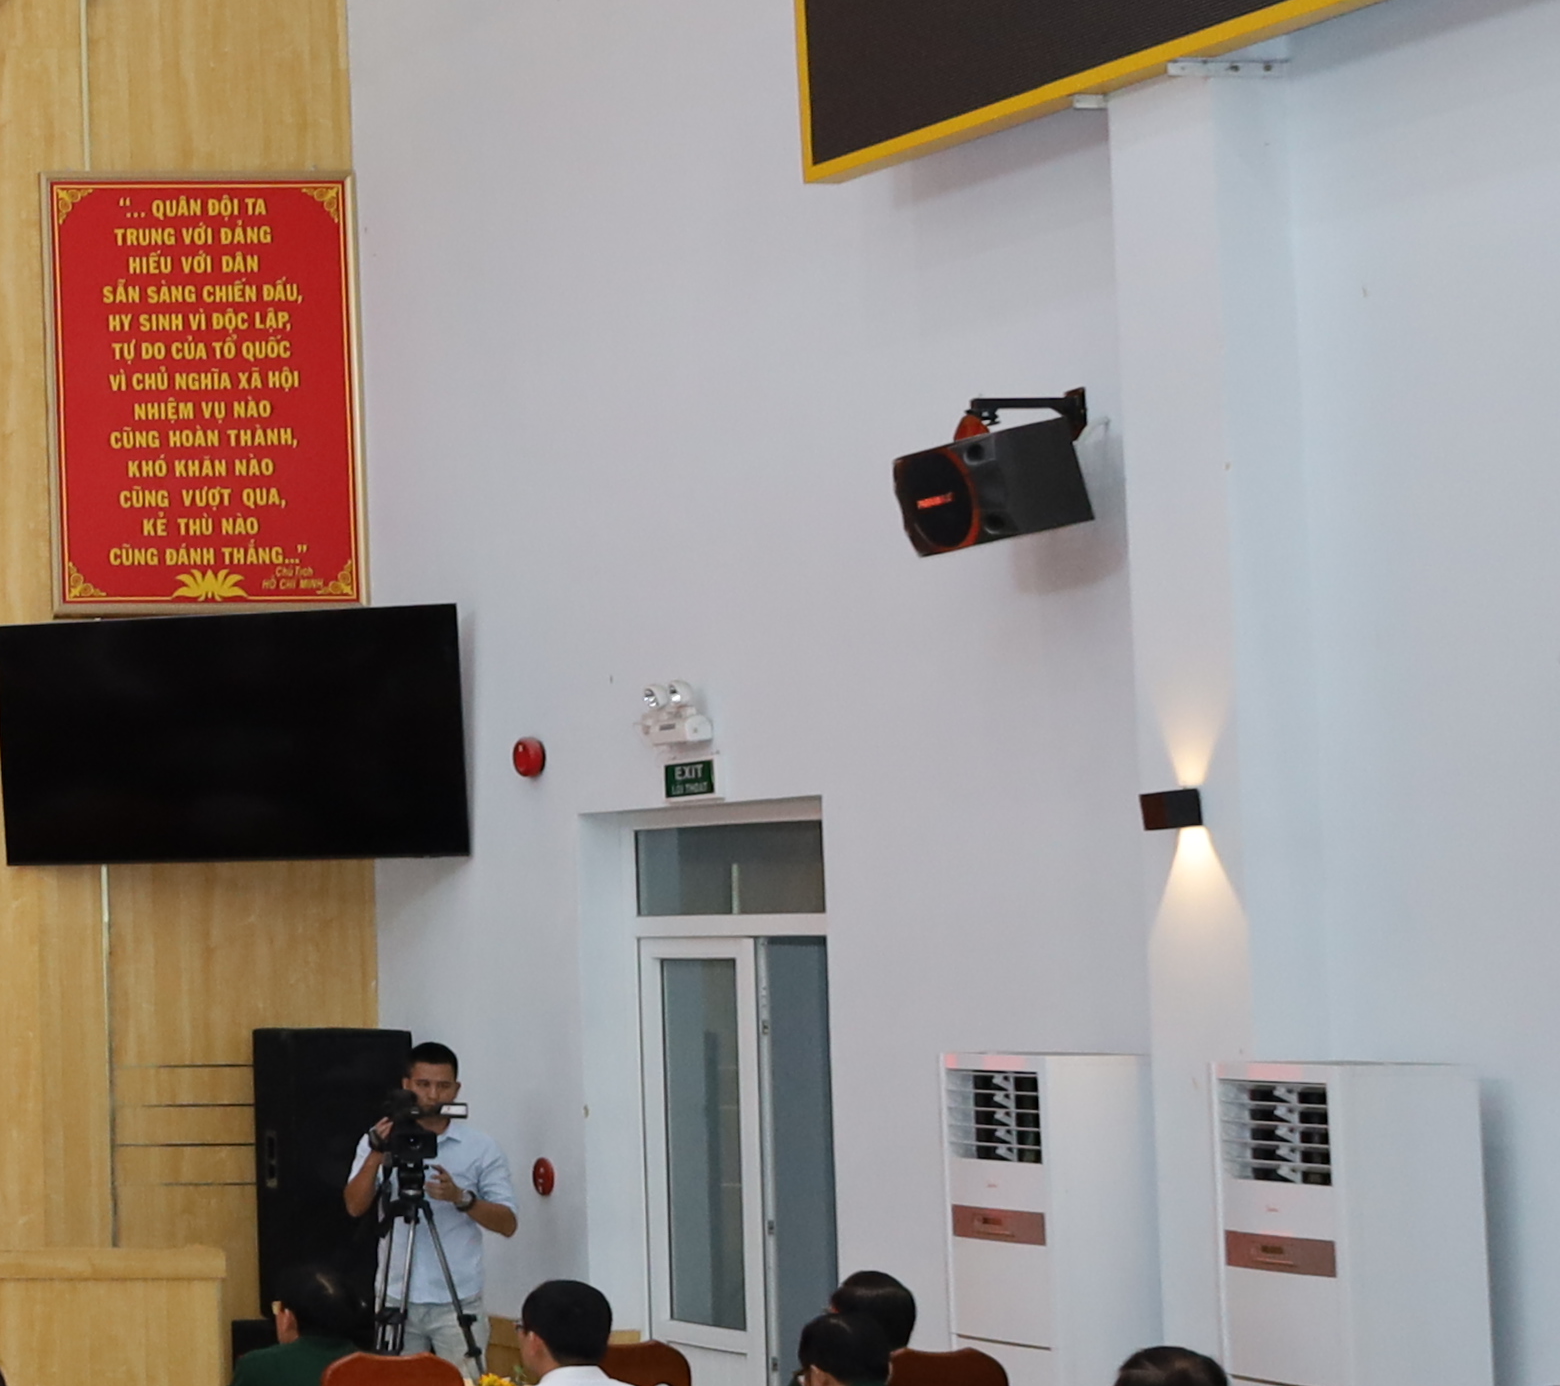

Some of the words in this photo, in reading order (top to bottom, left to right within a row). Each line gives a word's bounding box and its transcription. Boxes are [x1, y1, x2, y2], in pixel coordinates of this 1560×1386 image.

[152, 196, 201, 220] QUÂN
[208, 195, 241, 222] ĐỘI
[245, 198, 266, 215] TA
[114, 228, 175, 245] TRUNG
[182, 222, 212, 245] VỚI
[221, 220, 271, 244] ĐẢNG
[129, 250, 171, 274] HIẾU
[181, 251, 211, 273] VỚI
[222, 252, 258, 272] DÂN
[112, 339, 135, 364] TỰ
[142, 342, 165, 359] DO
[171, 336, 206, 359] CỦA
[212, 334, 237, 359] TỔ
[242, 335, 290, 361] QUỐC
[110, 369, 126, 391] VÌ
[132, 366, 168, 390] CHỦ
[175, 368, 231, 390] NGHĨA
[238, 368, 262, 389] XÃ
[268, 367, 298, 391] HỘI
[135, 397, 193, 423] NHIỆM
[202, 402, 225, 423] VỤ
[234, 397, 270, 418] NÀO
[110, 427, 160, 449] CŨNG
[169, 426, 218, 447] HOÀN
[227, 425, 297, 447] THÀNH,
[128, 454, 167, 477] KHÓ
[175, 456, 226, 477] KHĂN
[235, 454, 273, 476] NÀO
[120, 486, 169, 508] CŨNG
[182, 486, 231, 510] VƯỢT
[243, 488, 285, 508] QUA,
[143, 512, 167, 536] KẺ
[178, 513, 212, 535] THÙ
[222, 513, 258, 535] NÀO
[110, 544, 158, 565] CŨNG
[165, 544, 214, 565] ĐÁNH
